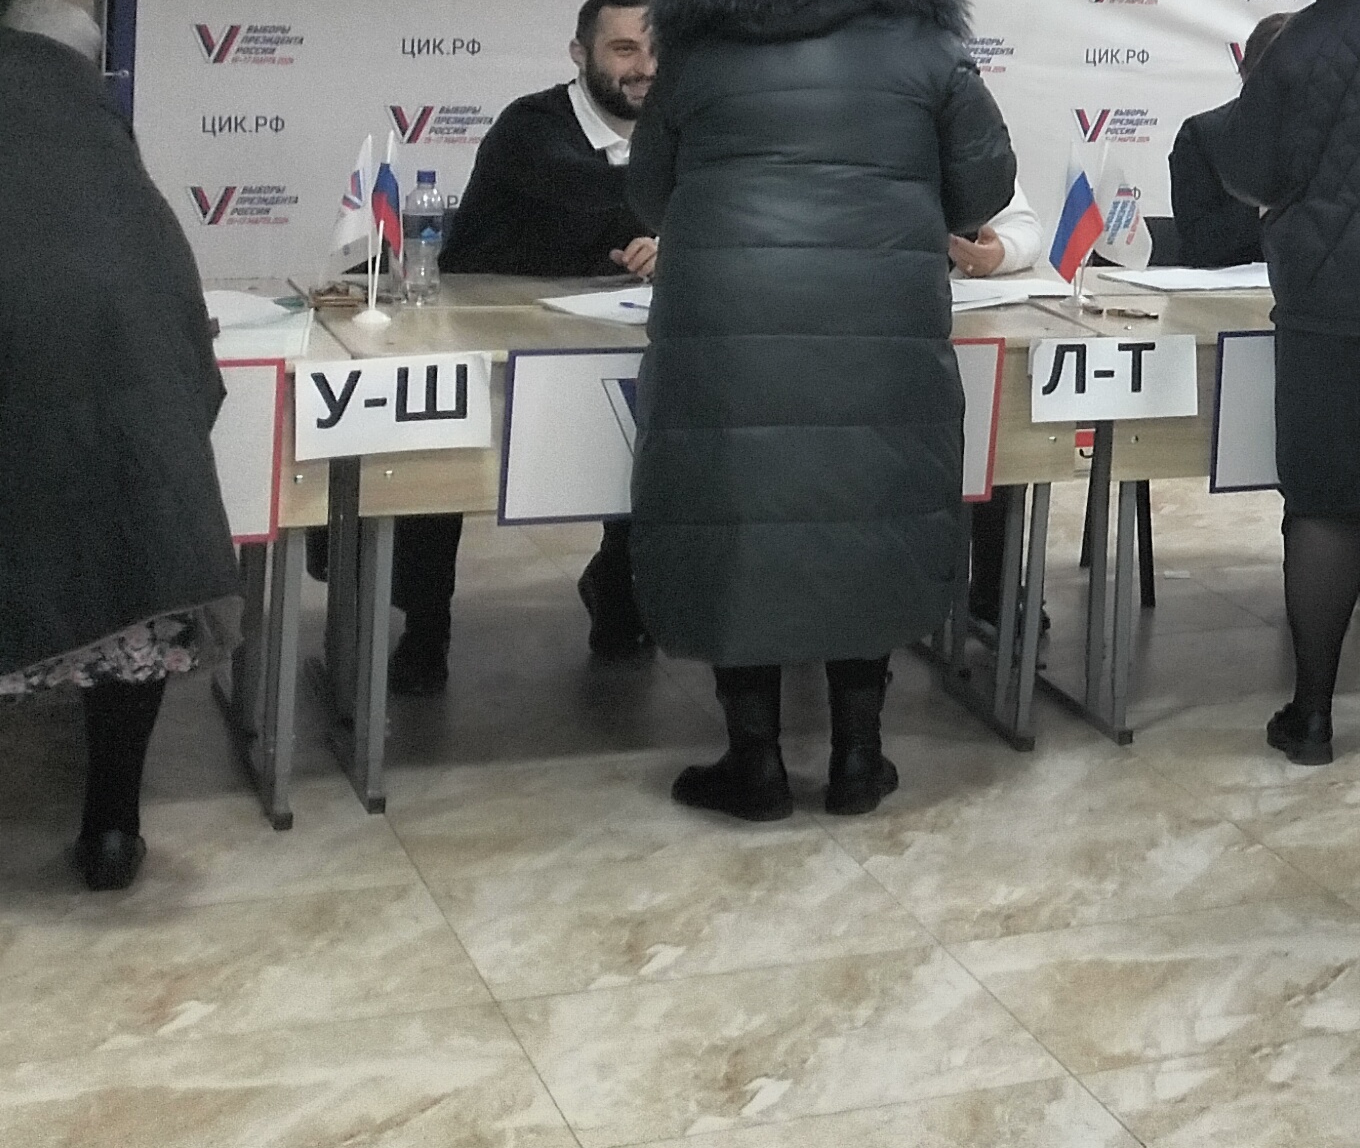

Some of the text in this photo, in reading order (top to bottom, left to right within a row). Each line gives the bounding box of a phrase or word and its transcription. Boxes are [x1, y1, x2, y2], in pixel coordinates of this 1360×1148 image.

[401, 37, 482, 58] ЦИК.РФ
[1085, 47, 1150, 67] ЦИК.РФ
[201, 114, 286, 137] ЦИК.РФ
[1041, 342, 1156, 395] Л-Т
[310, 363, 468, 429] У-Ш
